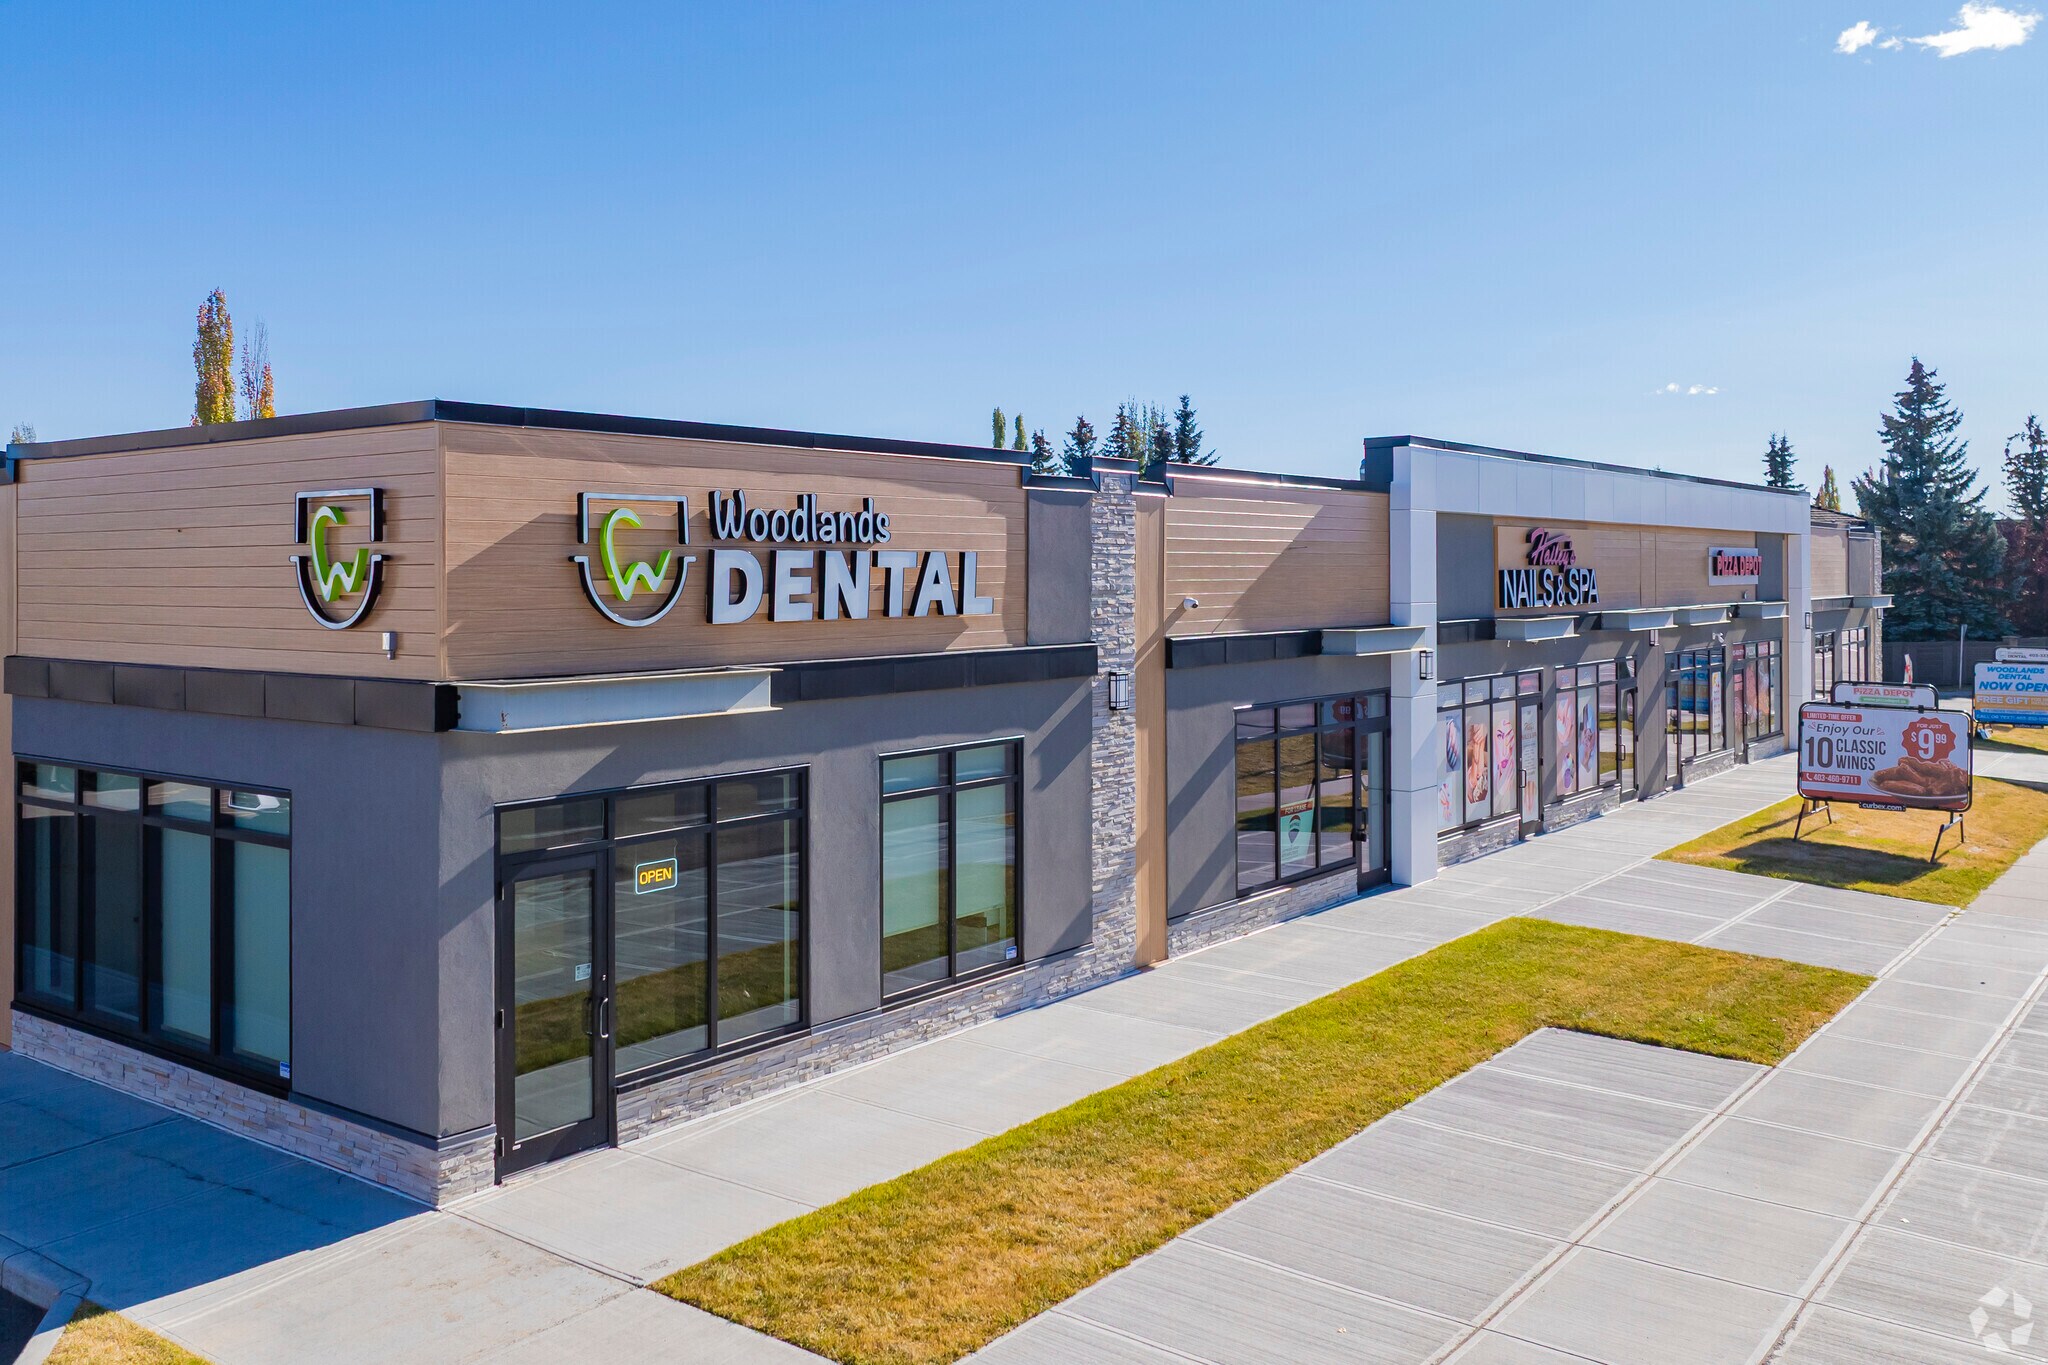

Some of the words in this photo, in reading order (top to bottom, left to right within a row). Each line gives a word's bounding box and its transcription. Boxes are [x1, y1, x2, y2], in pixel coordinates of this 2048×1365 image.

[708, 488, 891, 544] Woodlands
[1717, 551, 1739, 576] PIZZA
[1740, 556, 1763, 576] DEPOT
[707, 549, 995, 625] DENTAL
[1501, 568, 1555, 609] NAILS
[1556, 575, 1567, 607] &
[1567, 568, 1600, 607] SPA
[1853, 687, 1881, 696] PIZZA
[1883, 688, 1916, 698] DEPOT
[1979, 681, 2012, 690] NOW
[2015, 682, 2048, 692] OPEN
[1977, 695, 2003, 703] FREE
[2006, 696, 2028, 704] GIFT
[1806, 712, 1840, 720] LIMITED-TIME
[1816, 723, 1849, 736] Enjoy
[1852, 725, 1875, 736] Our
[1805, 736, 1834, 768] 10
[1836, 738, 1886, 755] CLASSIC
[1836, 754, 1876, 771] WINGS
[1813, 773, 1858, 784] 403-460-9711
[1284, 806, 1294, 815] FOR
[1862, 802, 1903, 811] curbex.com
[639, 867, 672, 885] OPEN
